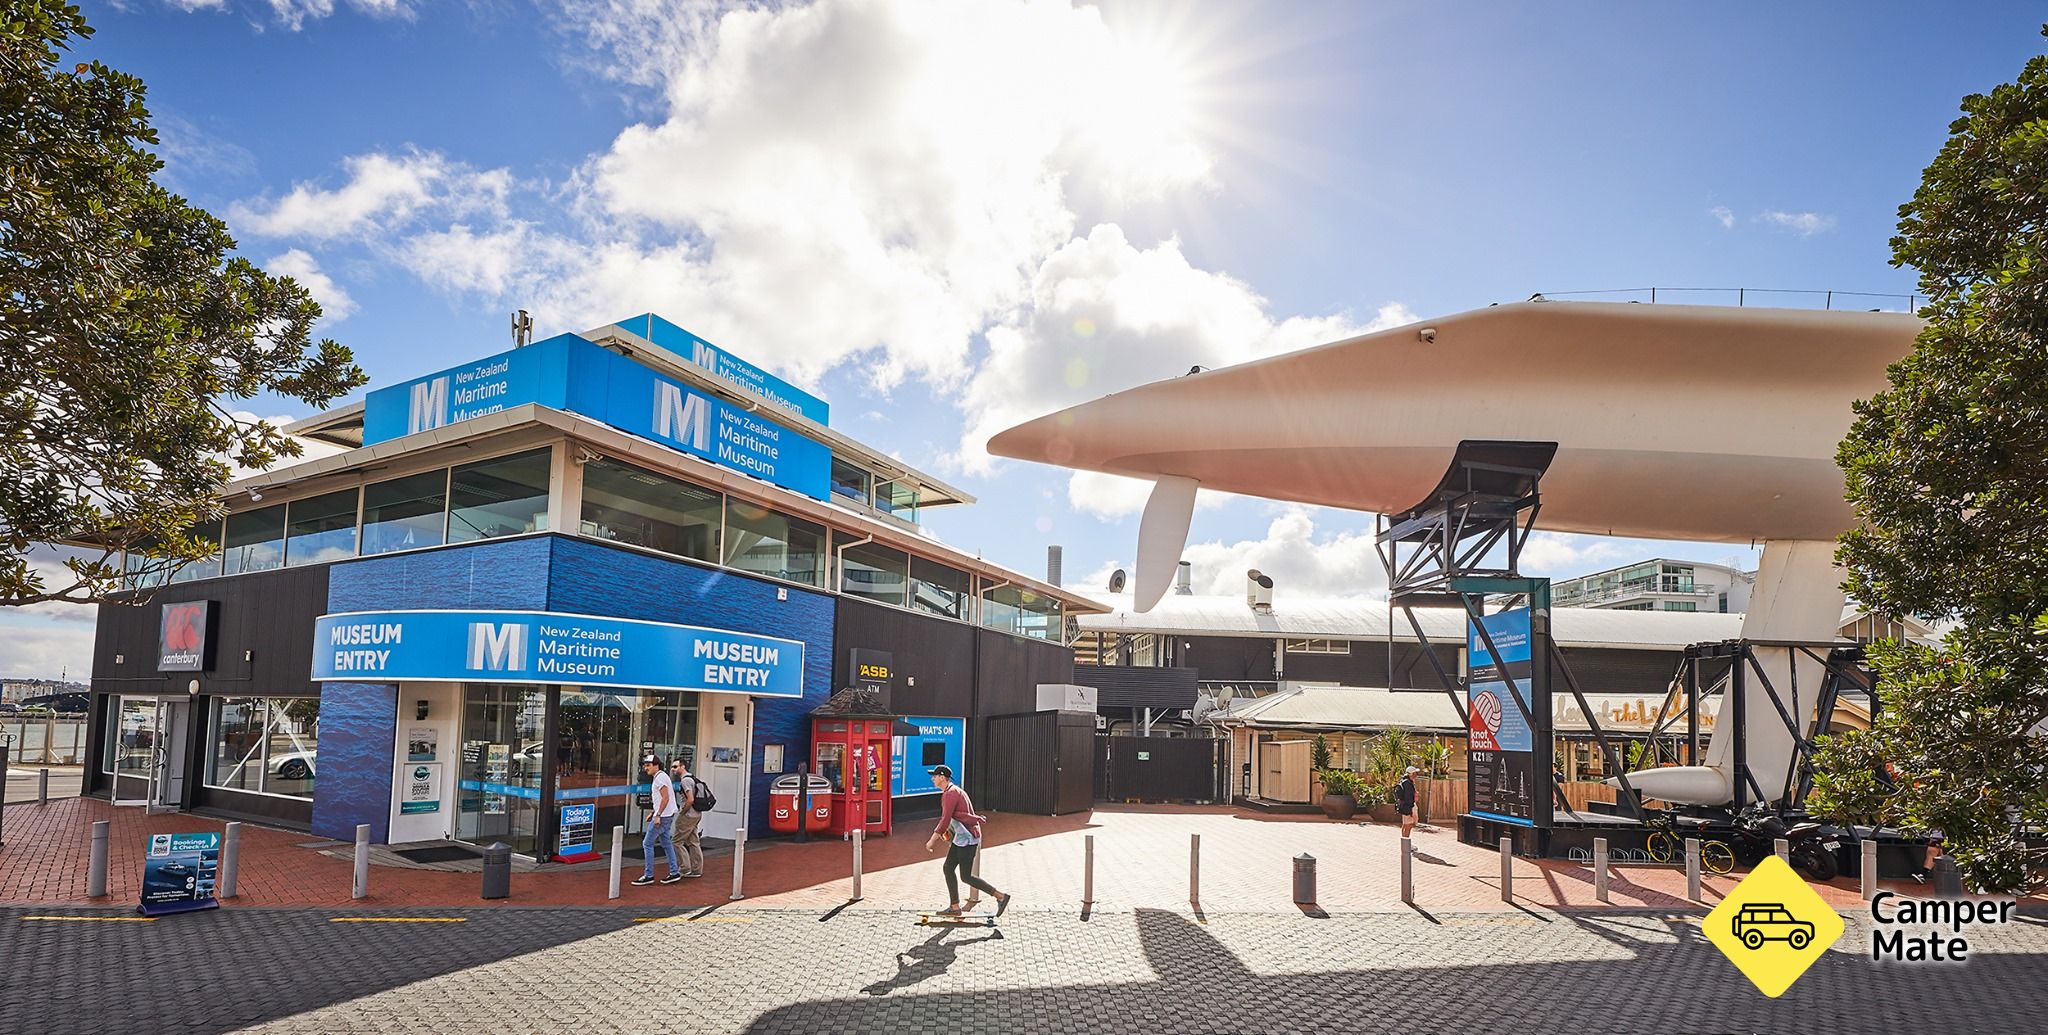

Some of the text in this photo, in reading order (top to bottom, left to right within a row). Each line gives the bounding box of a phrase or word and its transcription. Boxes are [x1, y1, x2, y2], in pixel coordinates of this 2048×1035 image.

[456, 360, 508, 385] New Zealand
[720, 355, 764, 382] New Zealand
[455, 379, 507, 405] Maritime
[719, 366, 802, 415] Maritime Museum
[453, 403, 502, 422] Museum
[720, 408, 779, 441] New Zealand
[719, 425, 779, 459] Maritime
[719, 442, 775, 477] Museum
[331, 624, 401, 646] MUSEUM
[540, 626, 621, 641] New Zealand
[163, 651, 199, 667] canterbury
[334, 650, 390, 670] ENTRY
[538, 640, 620, 660] Maritime
[693, 639, 779, 665] MUSEUM
[537, 658, 615, 676] Museum
[704, 665, 770, 686] ENTRY
[867, 685, 880, 693] ATM
[1613, 702, 1638, 722] The
[943, 726, 953, 735] ON
[1471, 728, 1488, 738] knot
[1472, 738, 1492, 748] touch
[1473, 752, 1484, 762] KZ1
[566, 808, 590, 816] Today's
